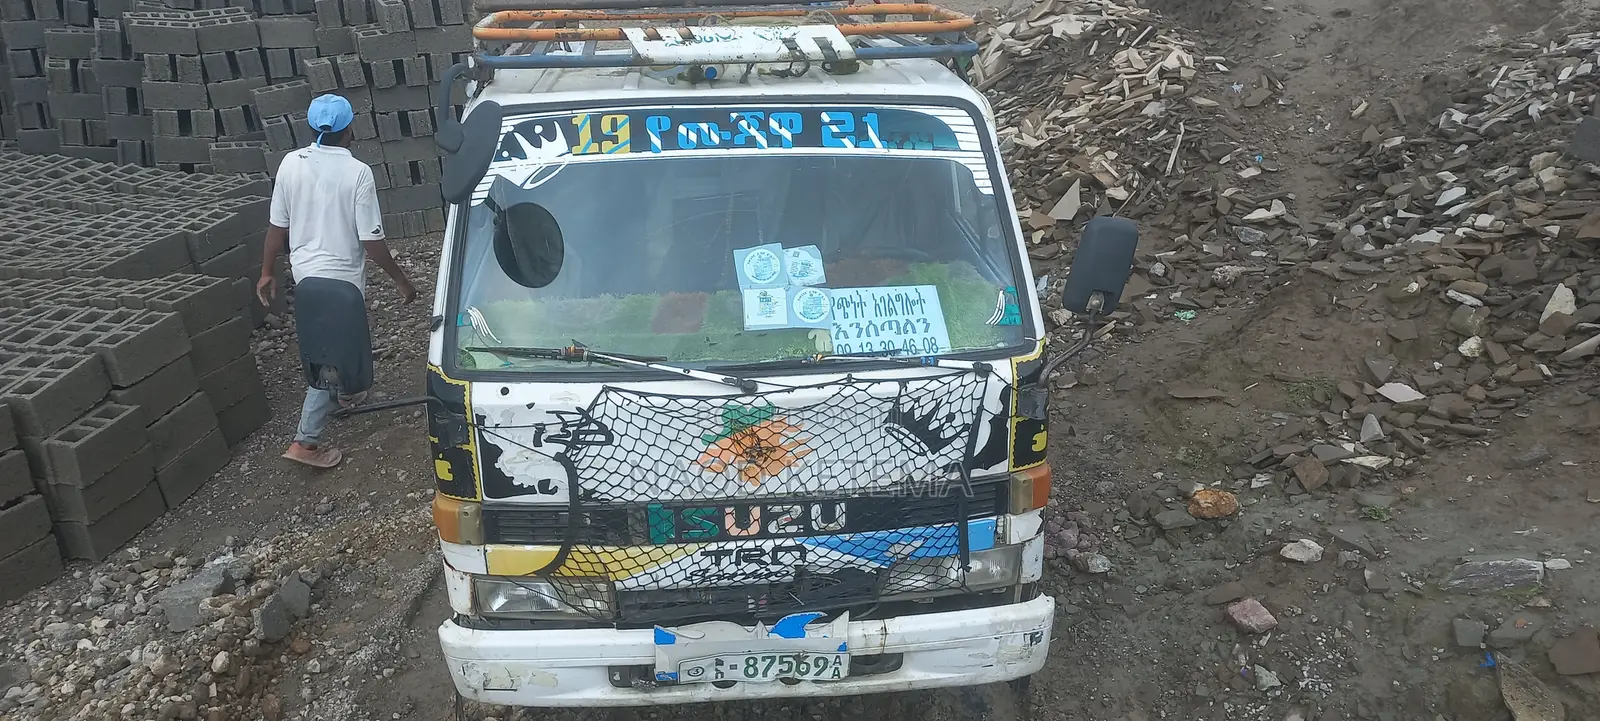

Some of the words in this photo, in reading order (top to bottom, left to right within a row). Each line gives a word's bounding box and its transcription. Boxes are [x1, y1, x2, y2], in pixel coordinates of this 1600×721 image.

[572, 114, 630, 154] 19
[820, 112, 888, 149] 21
[902, 338, 918, 355] 46
[922, 337, 939, 355] 08
[648, 502, 846, 544] ISUZU
[743, 654, 828, 678] 87569
